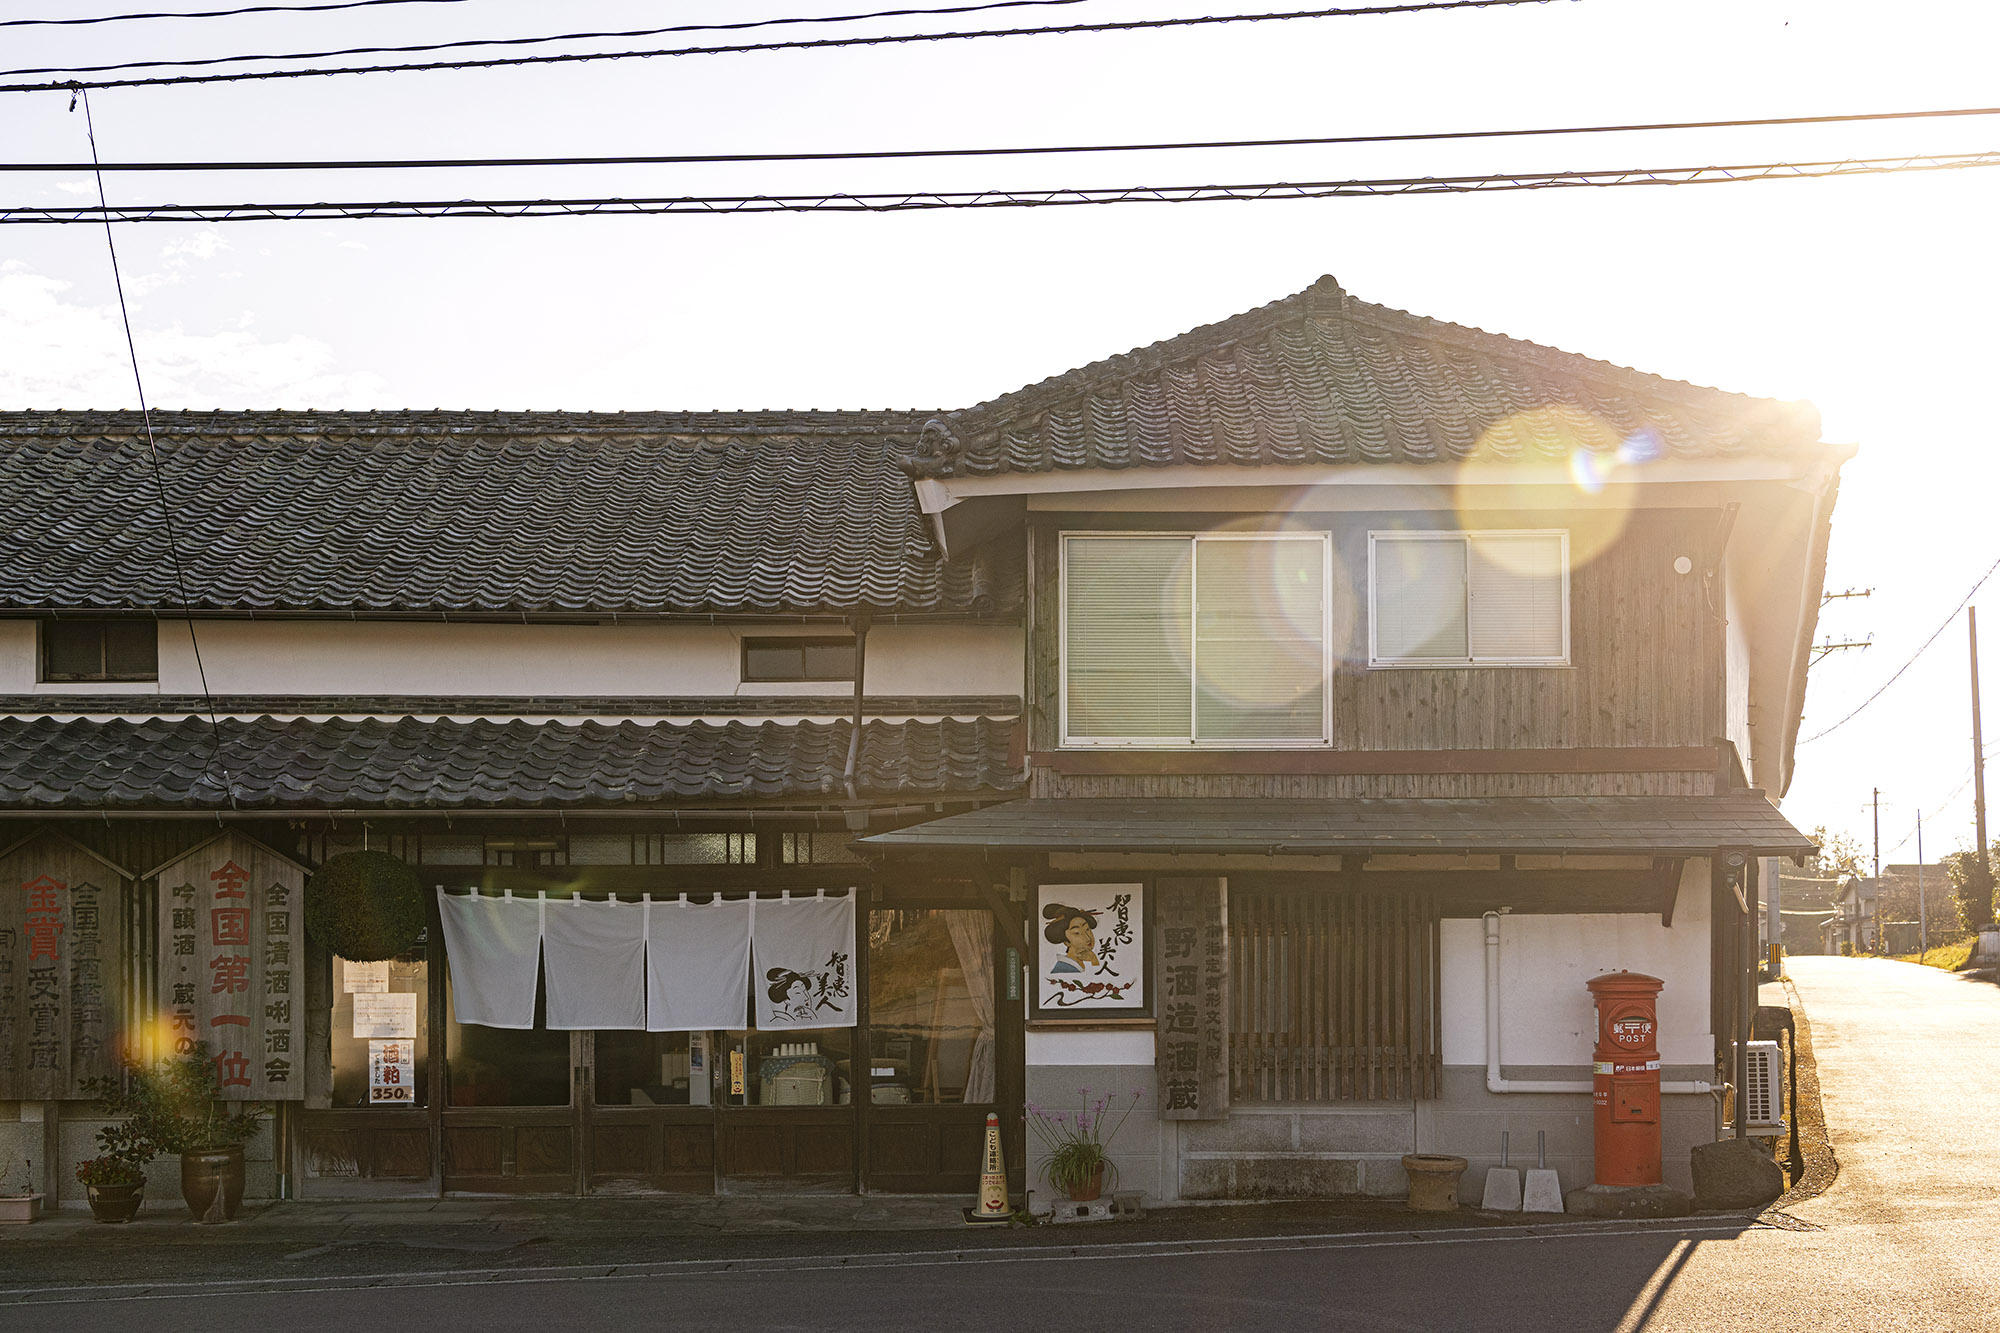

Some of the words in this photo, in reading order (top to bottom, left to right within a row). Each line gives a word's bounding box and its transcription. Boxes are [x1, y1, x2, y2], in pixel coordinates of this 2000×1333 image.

[21, 874, 67, 1071] 金賞受賞蔵
[210, 860, 251, 1087] 全国第一位
[383, 1045, 400, 1085] 酒粕
